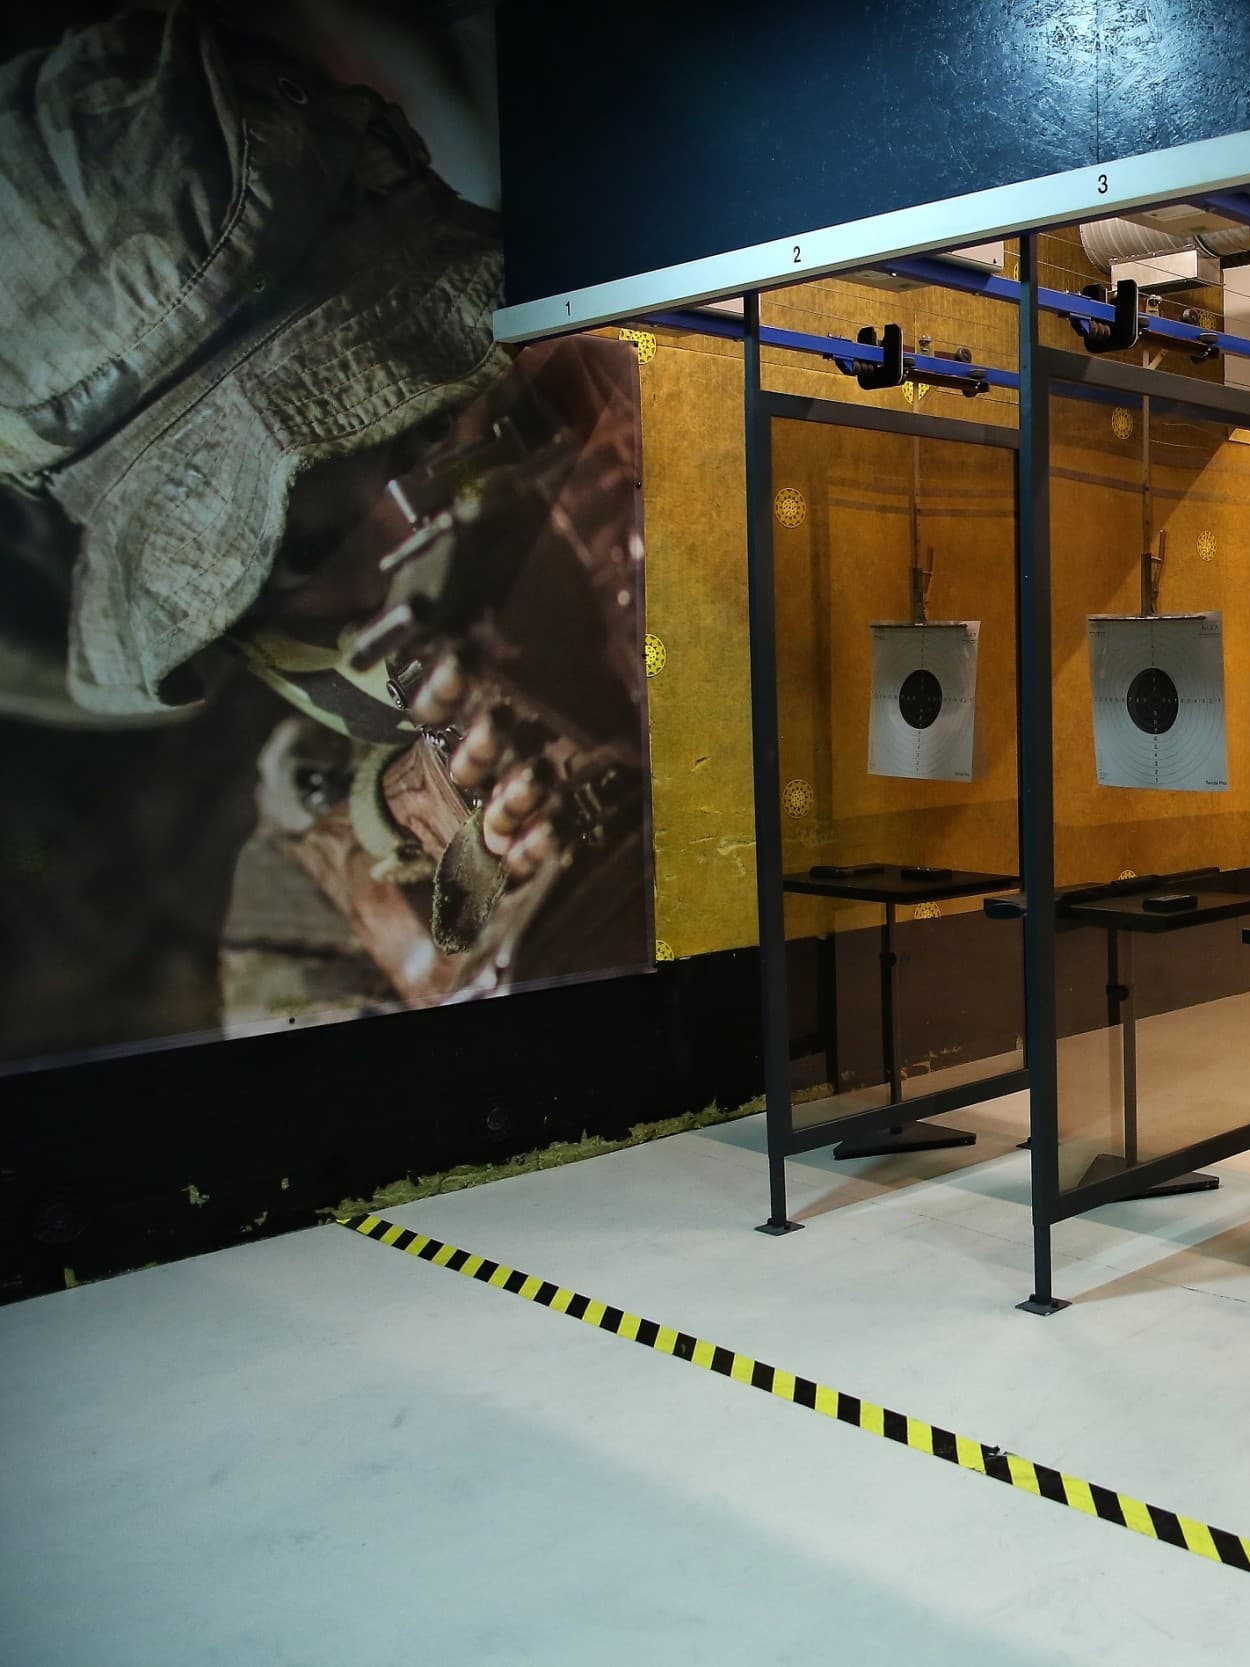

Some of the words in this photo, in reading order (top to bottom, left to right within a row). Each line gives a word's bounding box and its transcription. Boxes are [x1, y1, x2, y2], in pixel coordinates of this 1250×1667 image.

[1097, 174, 1108, 194] 3
[793, 245, 801, 263] 2
[565, 300, 571, 316] 1
